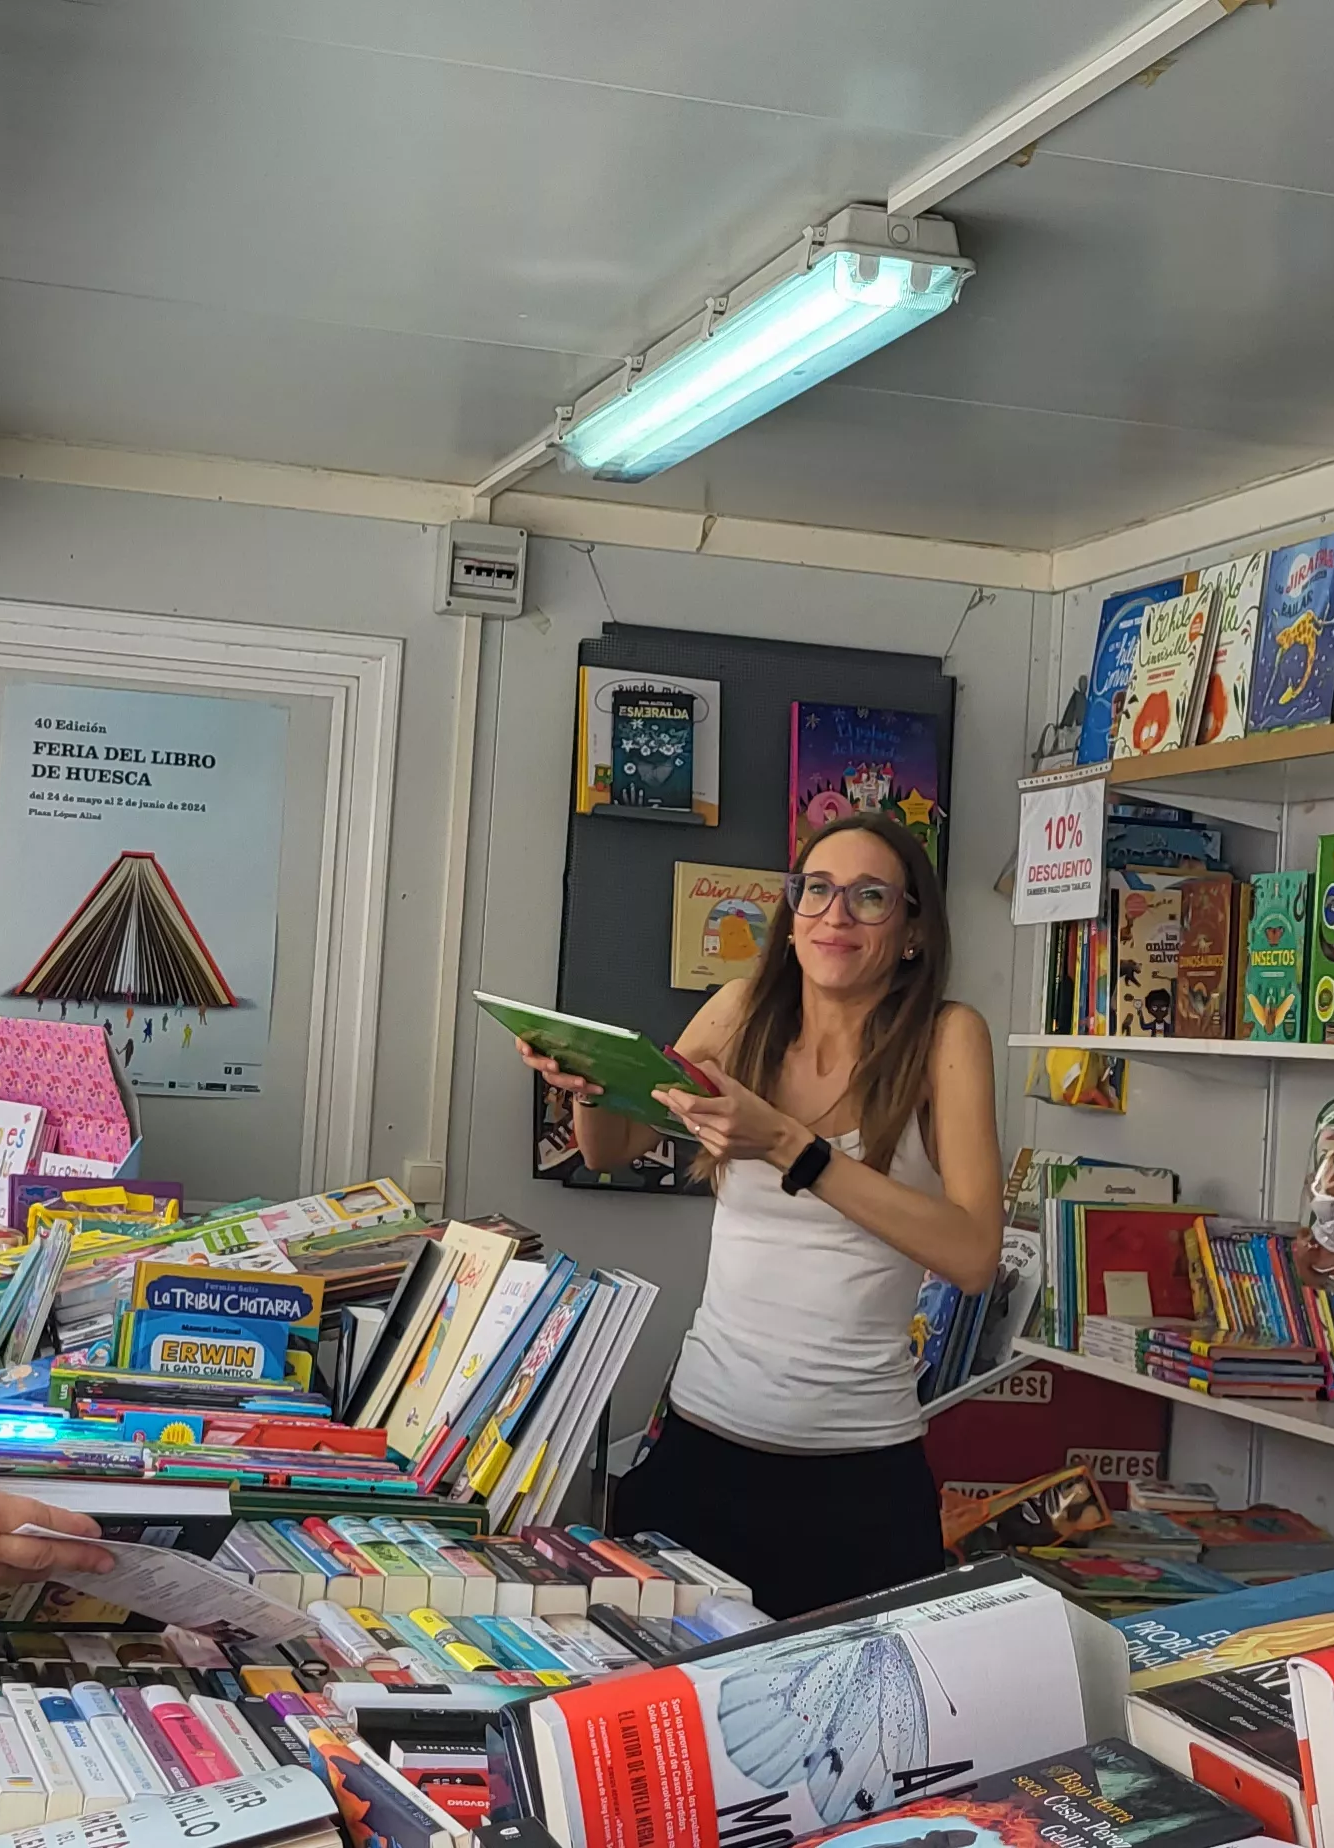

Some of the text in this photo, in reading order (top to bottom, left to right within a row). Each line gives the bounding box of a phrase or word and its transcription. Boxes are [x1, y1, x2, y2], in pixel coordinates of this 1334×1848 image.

[619, 706, 689, 720] ESMERALDA
[34, 717, 107, 734] 40 Edición
[33, 741, 216, 769] FERIA DEL LIBRO
[31, 764, 152, 787] DE HUESCA
[29, 791, 207, 813] del 24 de mayo al 2 de junio de 2024
[1045, 812, 1083, 851] 10%
[1028, 858, 1093, 883] DESCUENTO
[1251, 949, 1295, 966] INSECTOS
[6, 1128, 26, 1149] es
[171, 1288, 220, 1314] TRIBU
[161, 1340, 257, 1369] ERWIN
[160, 1364, 254, 1380] EL GATO CUÁNTICO
[983, 1373, 1048, 1398] erest
[928, 1607, 967, 1623] DE LA
[1125, 1620, 1234, 1673] PROBLEMA
[1197, 1629, 1233, 1650] EL
[647, 1704, 658, 1722] Solo
[659, 1701, 668, 1718] Son
[671, 1698, 680, 1715] Son
[651, 1723, 661, 1743] ellos
[663, 1718, 671, 1728] la
[675, 1716, 684, 1729] los
[666, 1729, 677, 1758] Unidad
[676, 1729, 688, 1758] peores
[654, 1744, 667, 1776] pueden
[670, 1758, 679, 1769] de
[618, 1710, 655, 1848] EL AUTOR DE NOVELA NEGRA
[672, 1771, 682, 1796] Casos
[1011, 1775, 1048, 1798] seca
[661, 1777, 672, 1813] resolver
[688, 1795, 696, 1807] los
[1054, 1772, 1134, 1824] Bajo tierra
[129, 1812, 149, 1824] LA
[1044, 1795, 1133, 1848] César Pérez
[666, 1820, 675, 1839] caso
